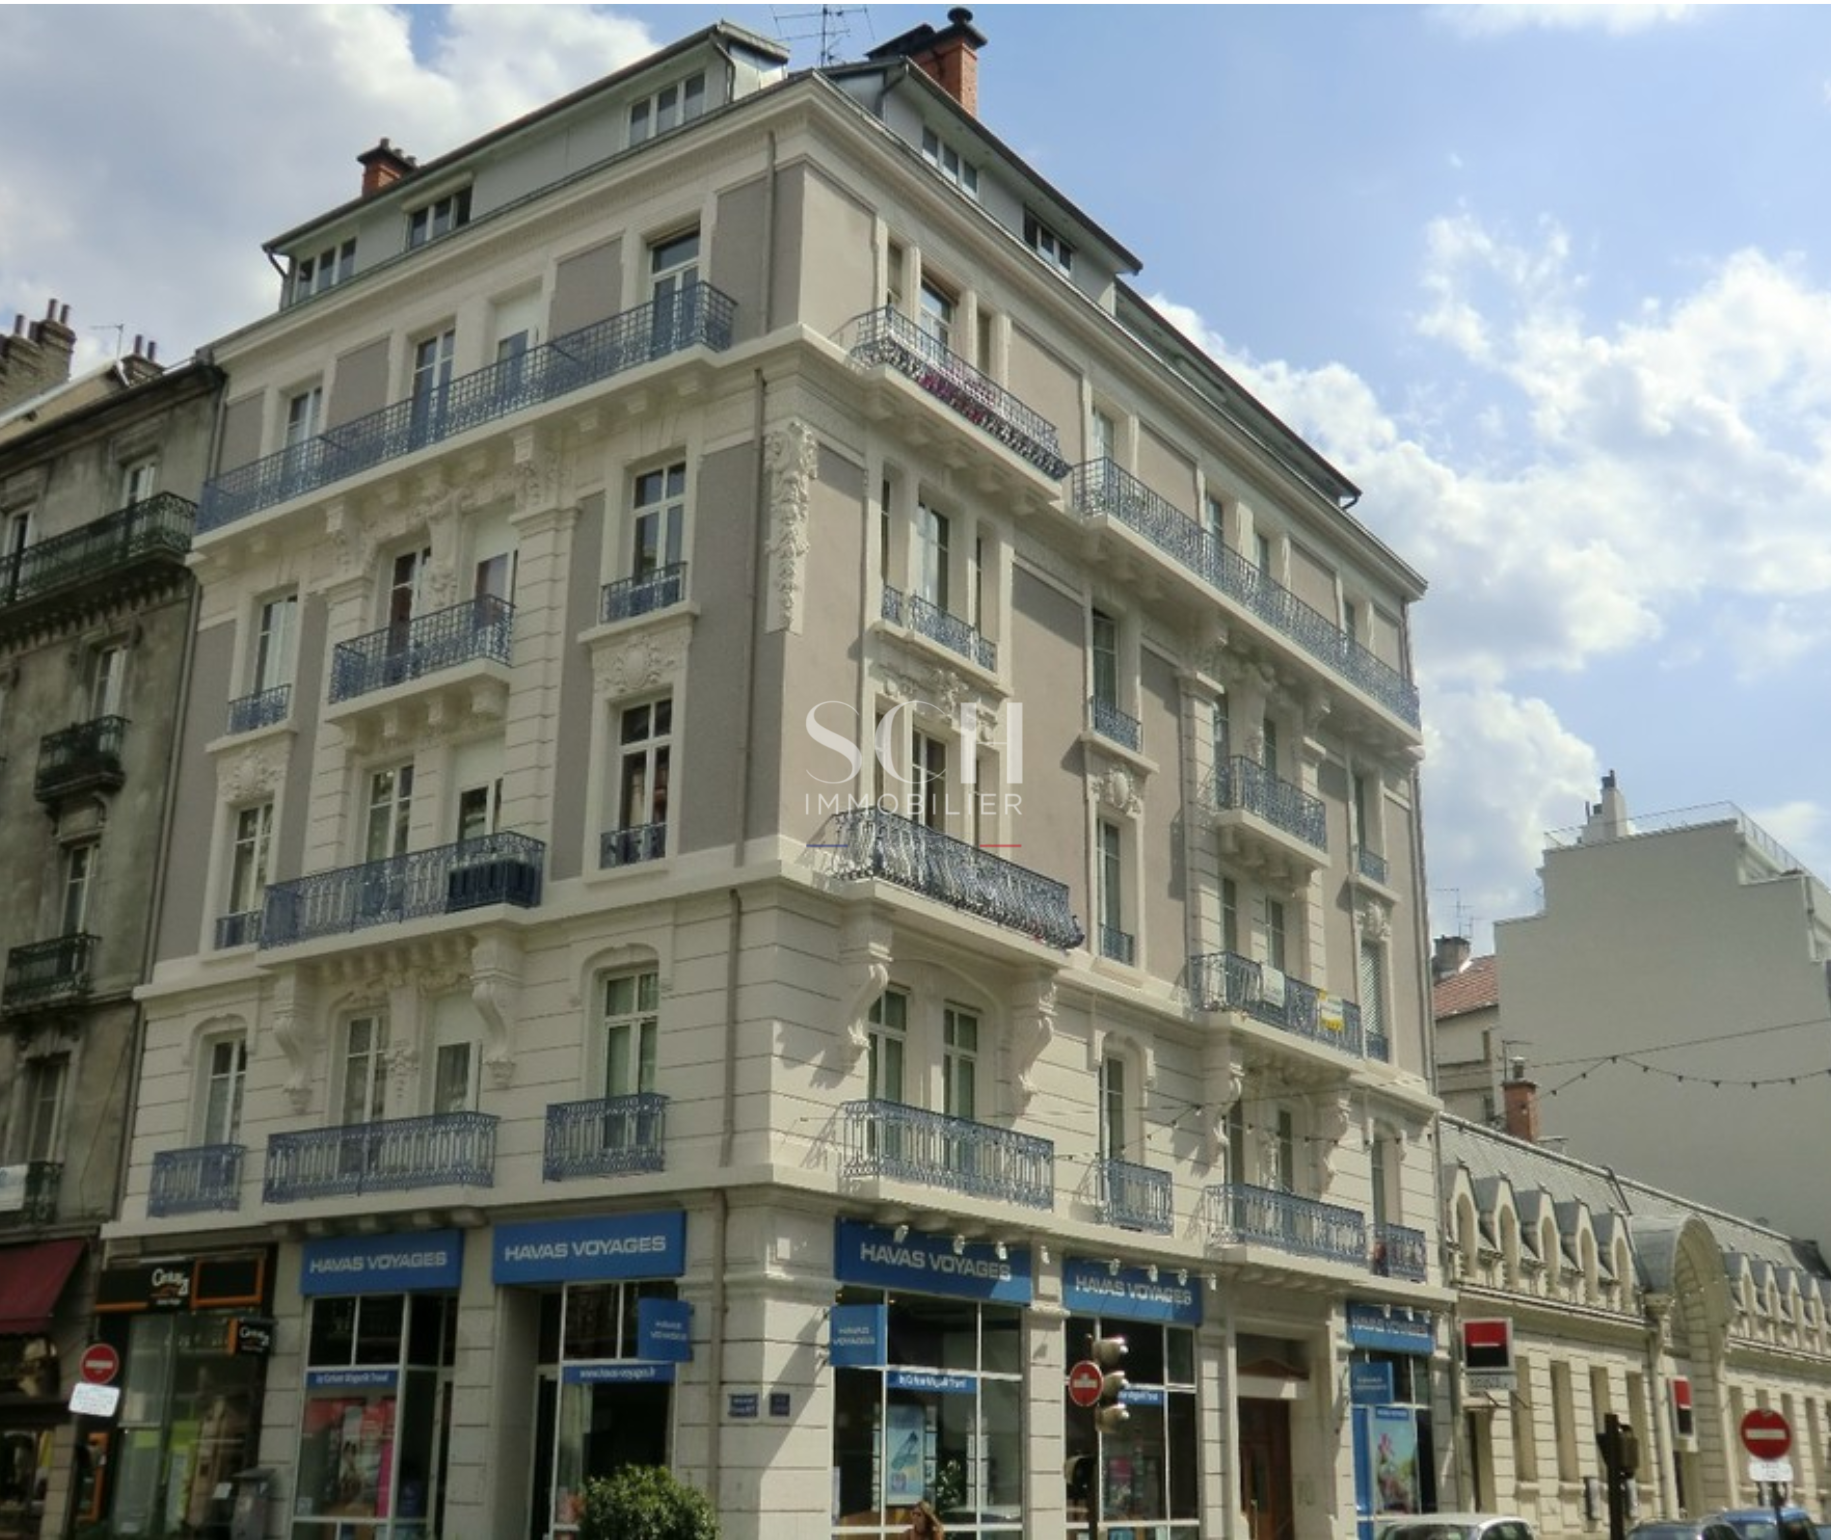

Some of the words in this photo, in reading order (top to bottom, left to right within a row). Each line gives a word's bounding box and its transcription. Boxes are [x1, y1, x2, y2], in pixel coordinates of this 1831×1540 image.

[310, 1256, 364, 1274] HAVAS
[367, 1250, 448, 1270] VOYAGES
[504, 1242, 568, 1262] HAVAS
[571, 1235, 667, 1257] VOYAGES
[860, 1242, 926, 1269] HAVAS
[929, 1253, 1012, 1282] VOYAGES
[1075, 1274, 1125, 1297] HAVAS
[1127, 1282, 1192, 1305] VOYAGES
